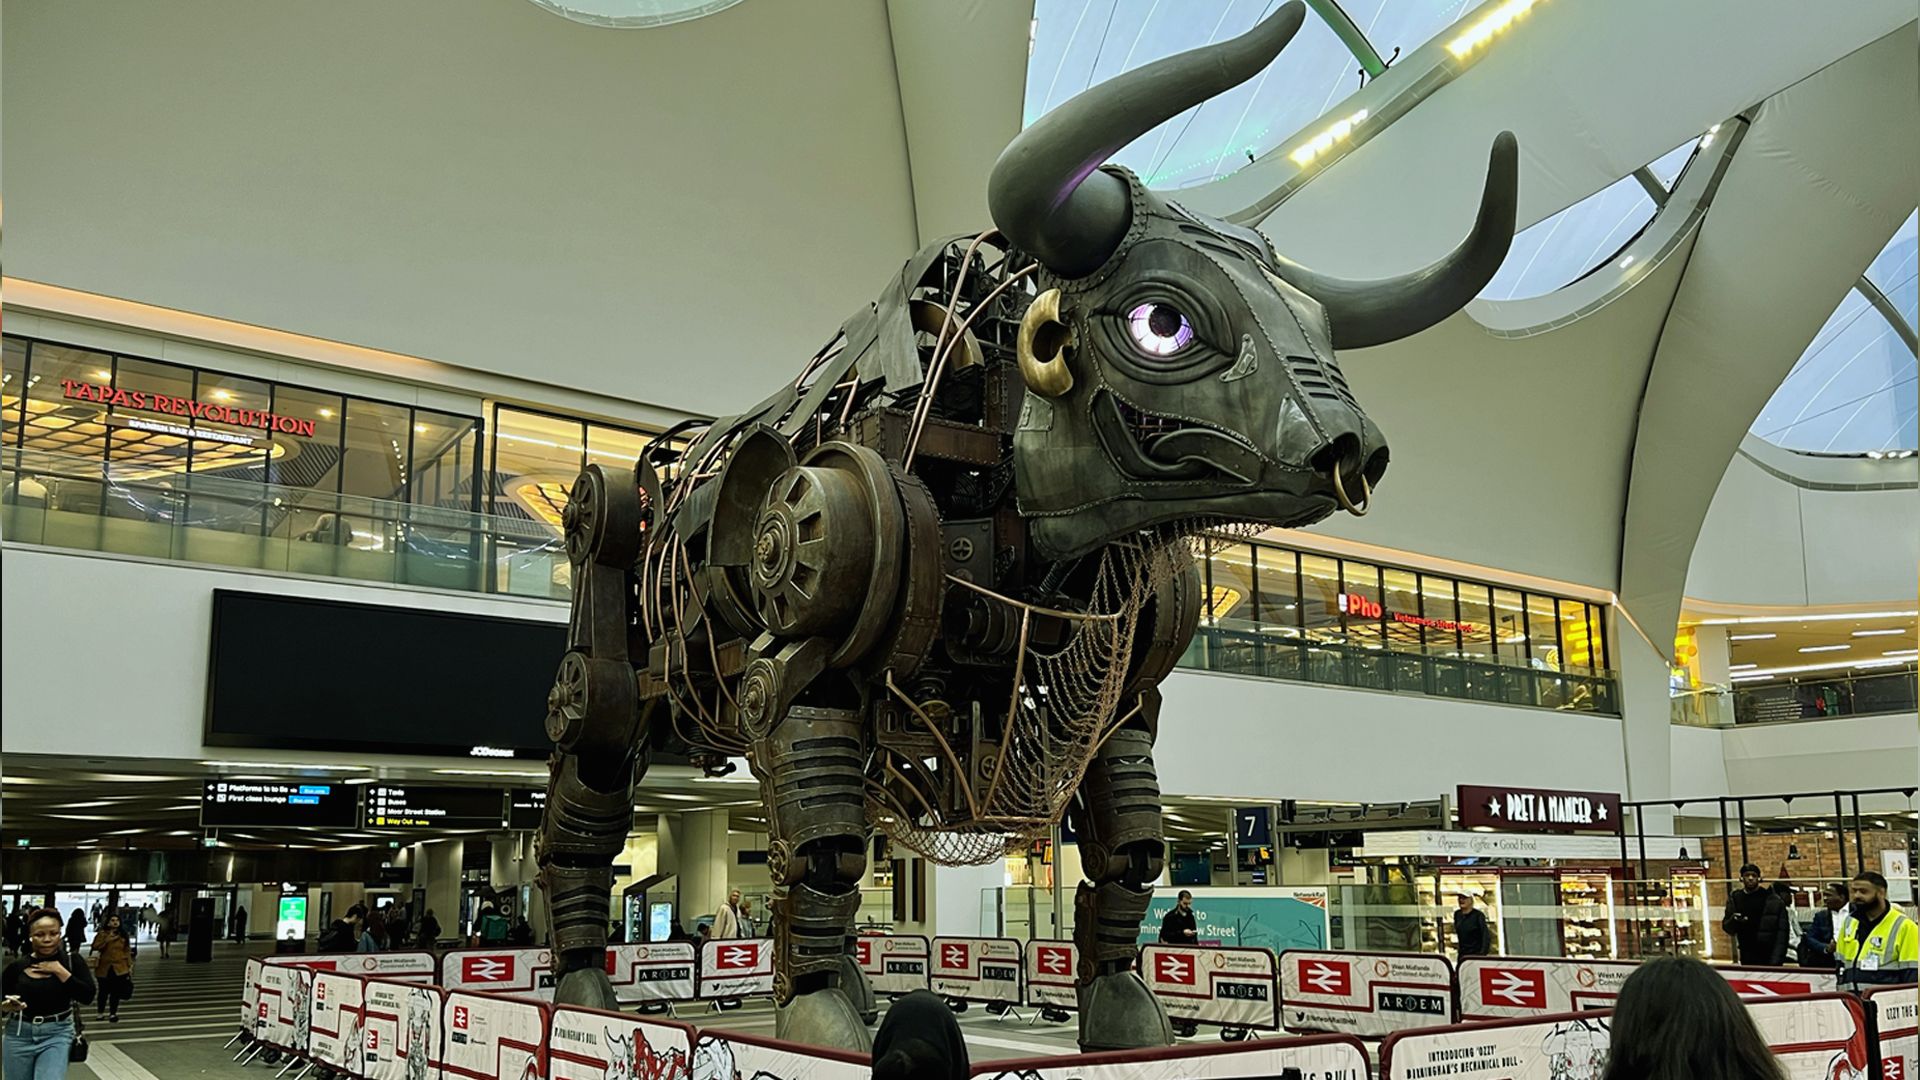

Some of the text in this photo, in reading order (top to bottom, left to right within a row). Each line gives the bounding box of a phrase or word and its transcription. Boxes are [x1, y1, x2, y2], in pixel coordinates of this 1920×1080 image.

[61, 379, 316, 437] TAPAS REVOLUTION
[1349, 593, 1383, 619] Pho
[228, 794, 245, 802] First
[1506, 792, 1593, 824] PRET A MANGER
[1244, 815, 1257, 837] 7
[1500, 839, 1519, 850] Good
[1520, 840, 1537, 851] Food
[1196, 909, 1207, 921] to
[1206, 924, 1236, 937] Street
[1901, 1005, 1913, 1018] THE
[1428, 1047, 1475, 1063] INTRODUCING
[1406, 1063, 1459, 1080] BIRMINGHAM'S
[1460, 1058, 1500, 1073] MECHANICAL
[1501, 1056, 1518, 1067] BULL
